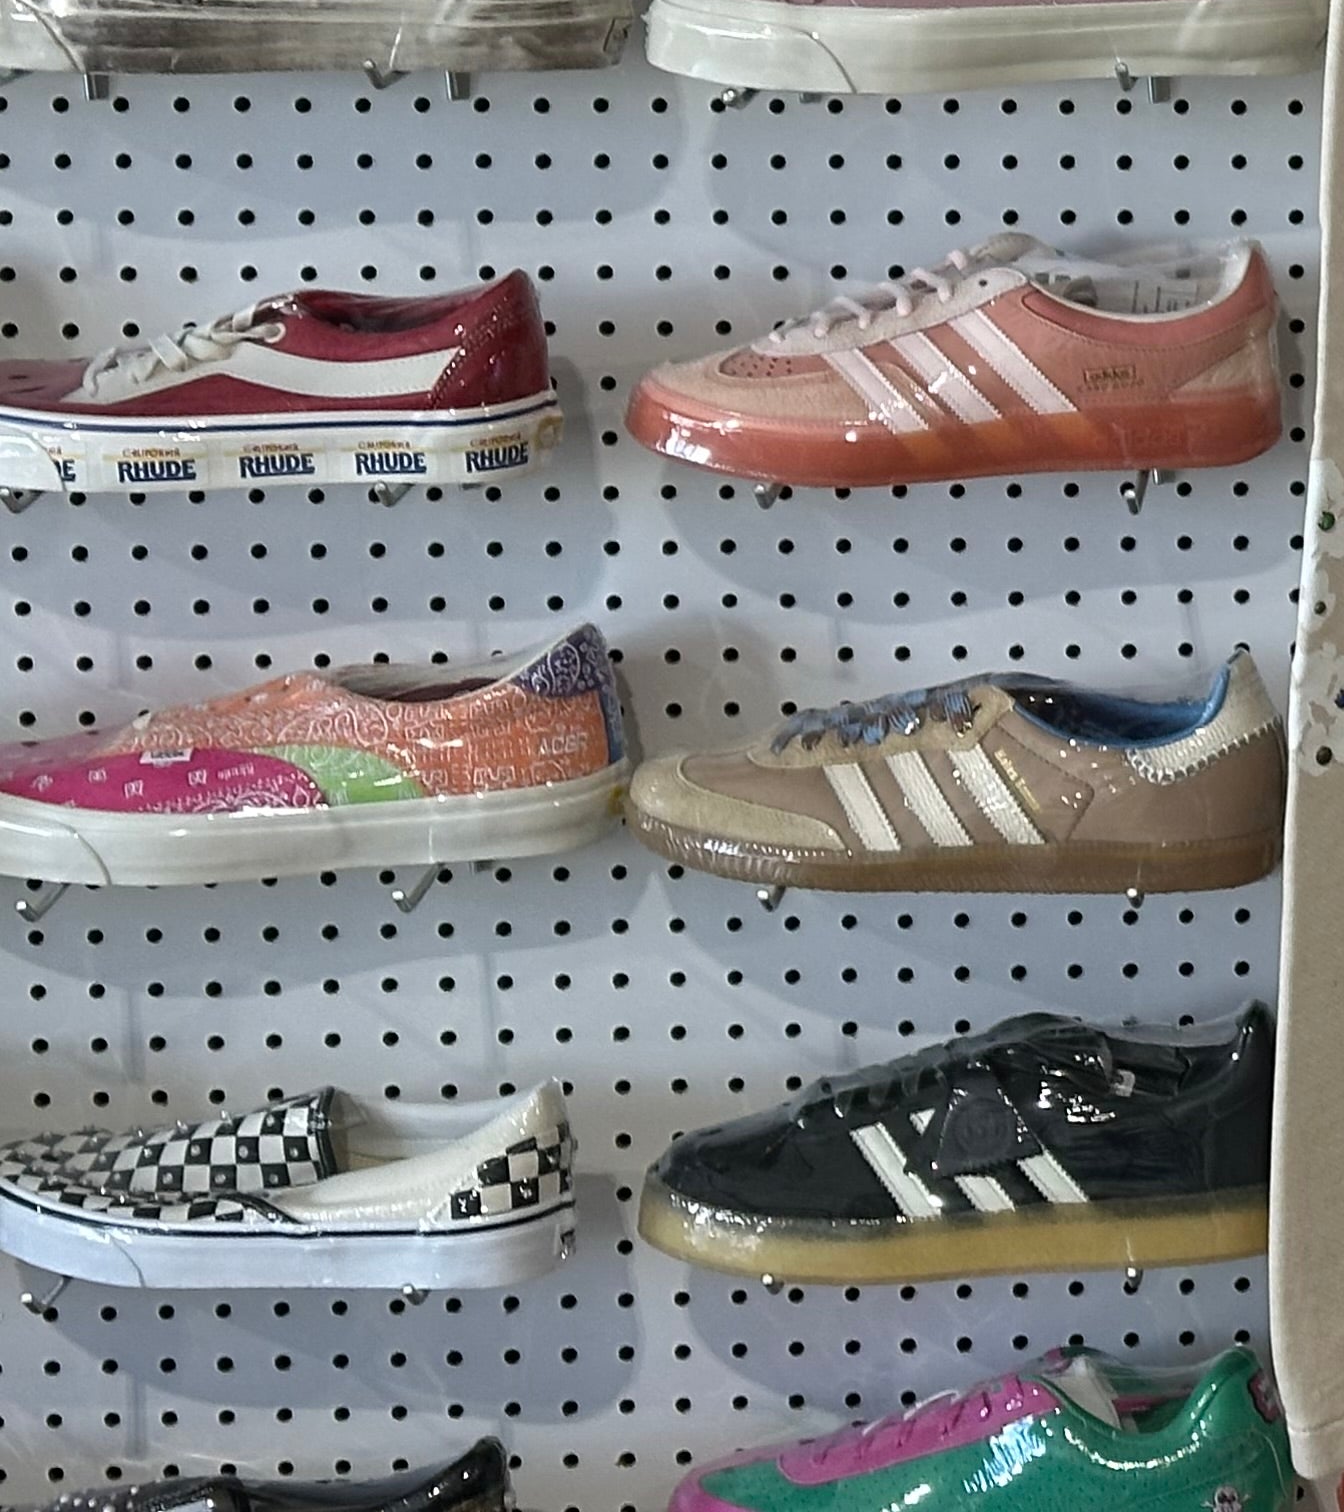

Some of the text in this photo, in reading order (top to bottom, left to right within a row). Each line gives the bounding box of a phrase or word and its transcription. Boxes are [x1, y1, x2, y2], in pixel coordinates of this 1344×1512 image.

[239, 453, 316, 479] RHUDE
[355, 451, 427, 475] RHUDE
[465, 442, 529, 473] RHUDE
[117, 458, 197, 483] RHUDE
